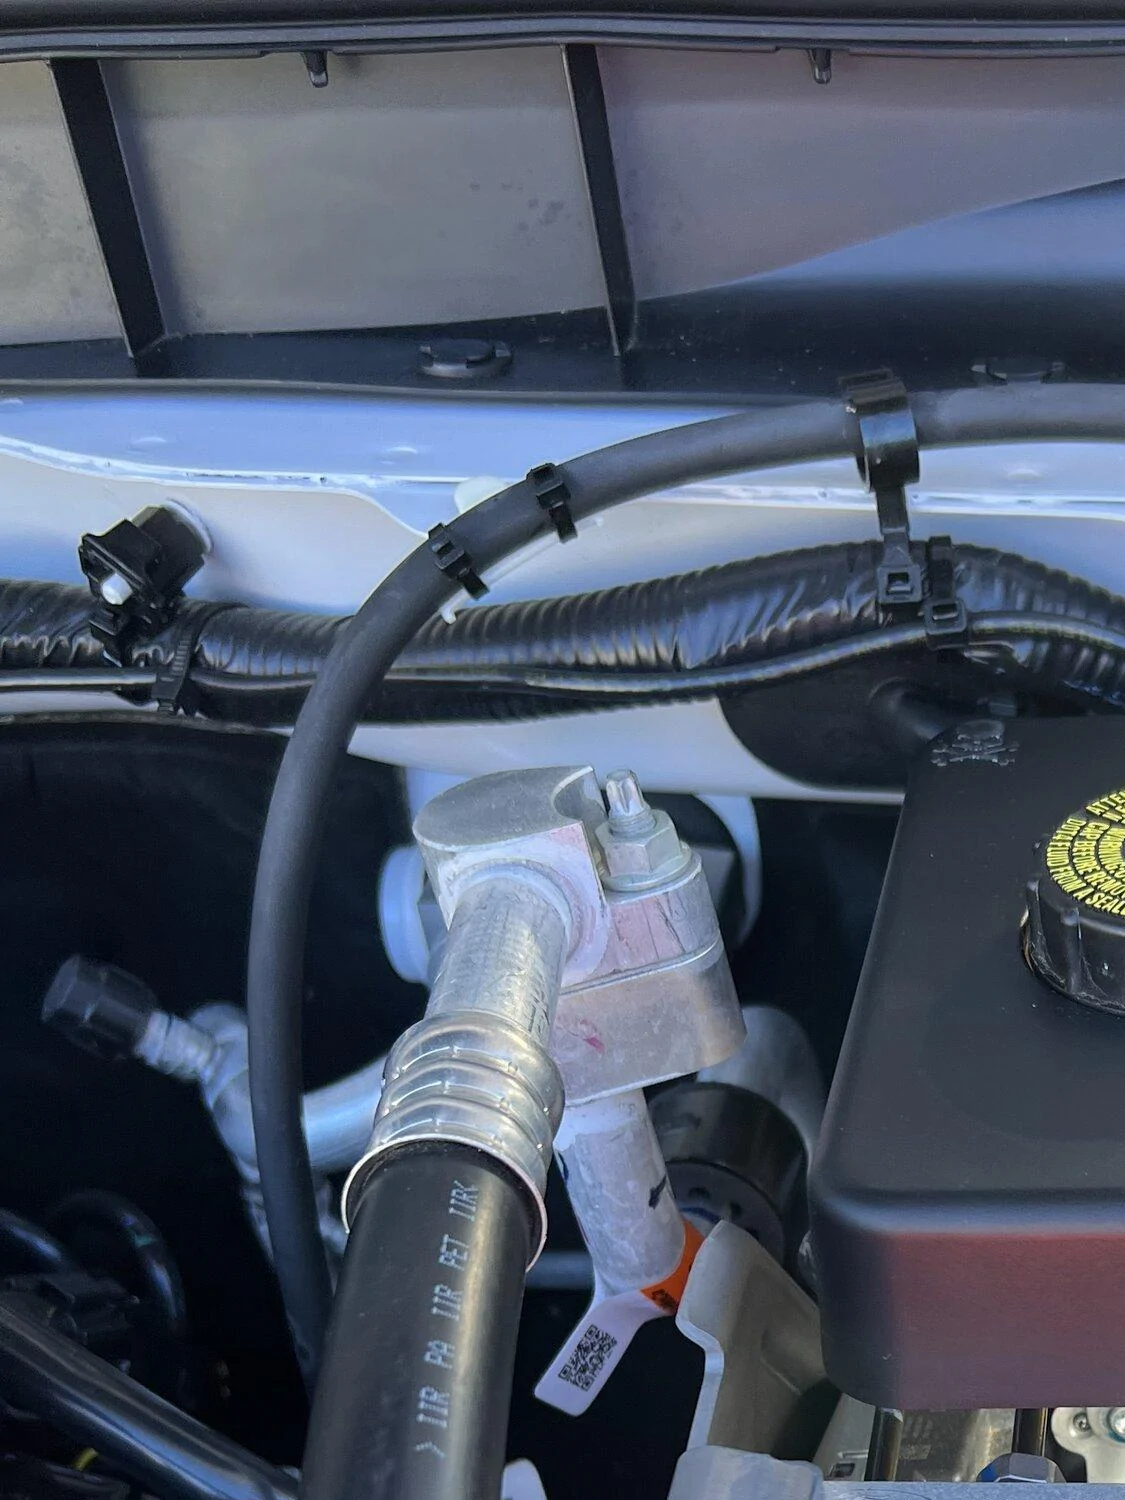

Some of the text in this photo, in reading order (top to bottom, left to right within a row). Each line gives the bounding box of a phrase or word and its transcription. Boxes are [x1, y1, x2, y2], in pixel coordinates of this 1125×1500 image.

[1079, 822, 1110, 840] CAP
[1046, 841, 1071, 867] FLUID
[1072, 841, 1101, 875] BEFORE
[1049, 865, 1087, 893] FROM
[1072, 887, 1094, 900] A
[438, 1233, 469, 1272] PET
